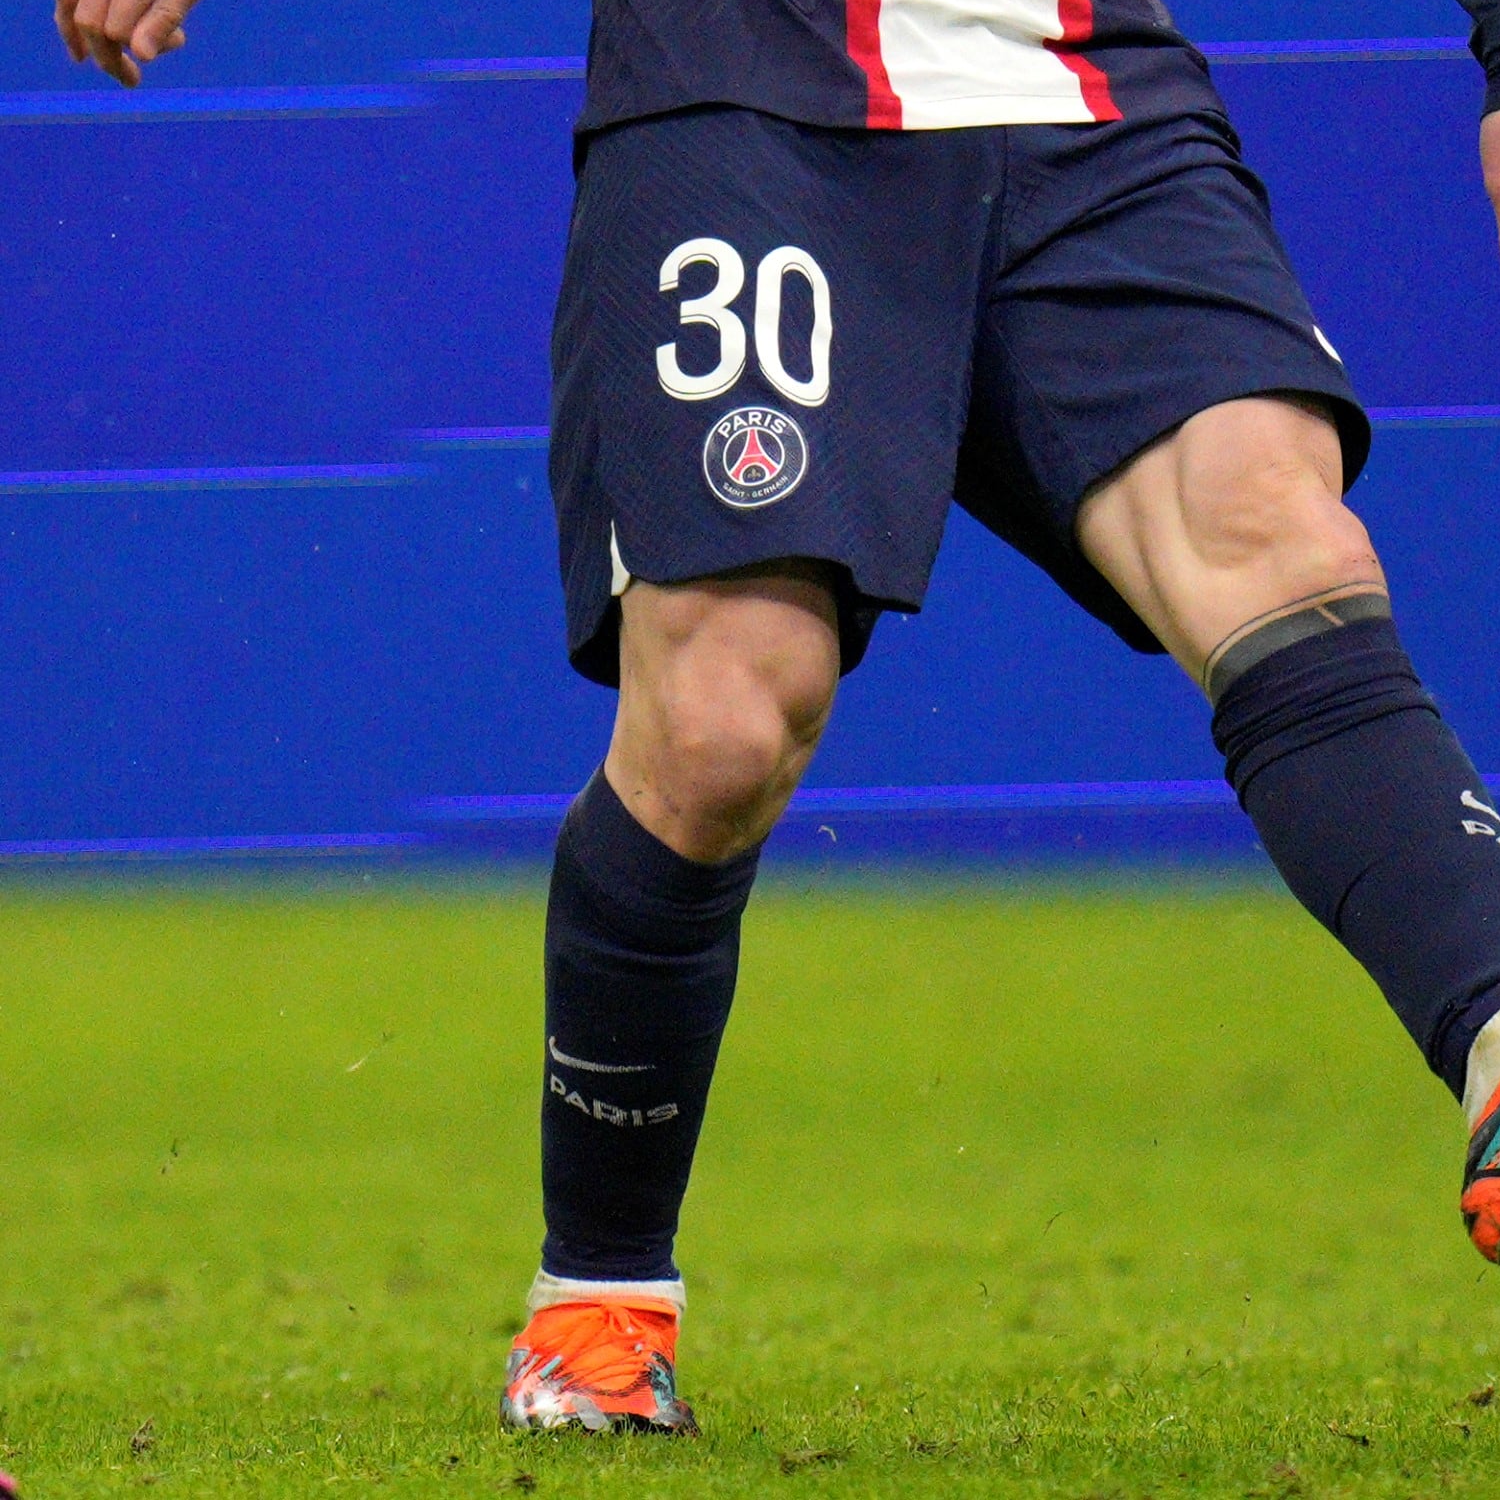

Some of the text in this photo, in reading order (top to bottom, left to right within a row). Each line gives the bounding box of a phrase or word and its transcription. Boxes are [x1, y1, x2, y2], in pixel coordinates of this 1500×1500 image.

[656, 237, 833, 408] 30
[717, 411, 787, 439] PARIS
[550, 1072, 679, 1127] PARIS
